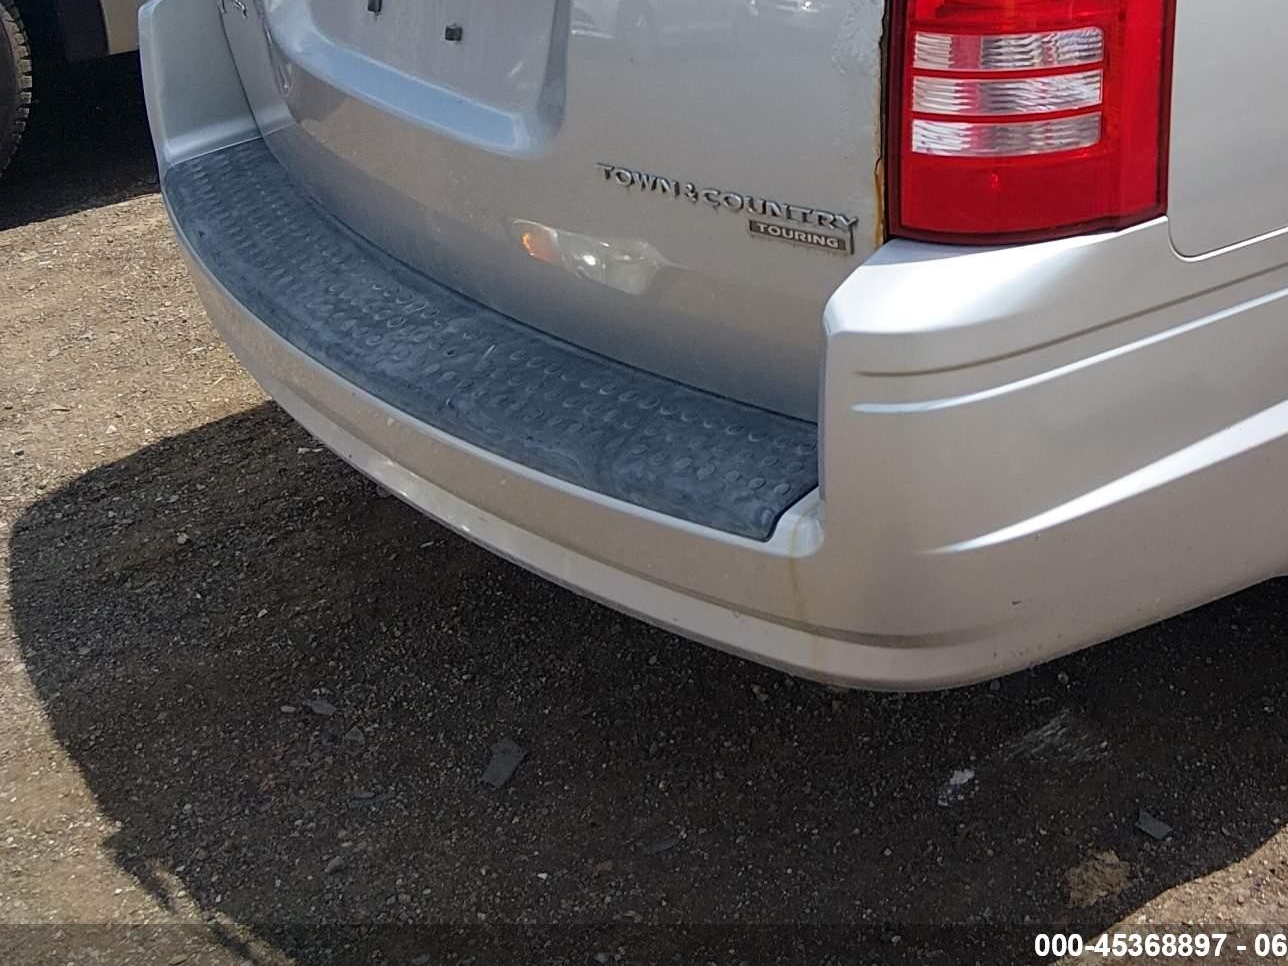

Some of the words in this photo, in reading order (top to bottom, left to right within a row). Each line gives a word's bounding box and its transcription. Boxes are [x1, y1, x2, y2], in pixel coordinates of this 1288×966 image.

[594, 162, 680, 198] TOWN
[702, 188, 859, 231] COUNTRY
[756, 223, 840, 249] TOURING
